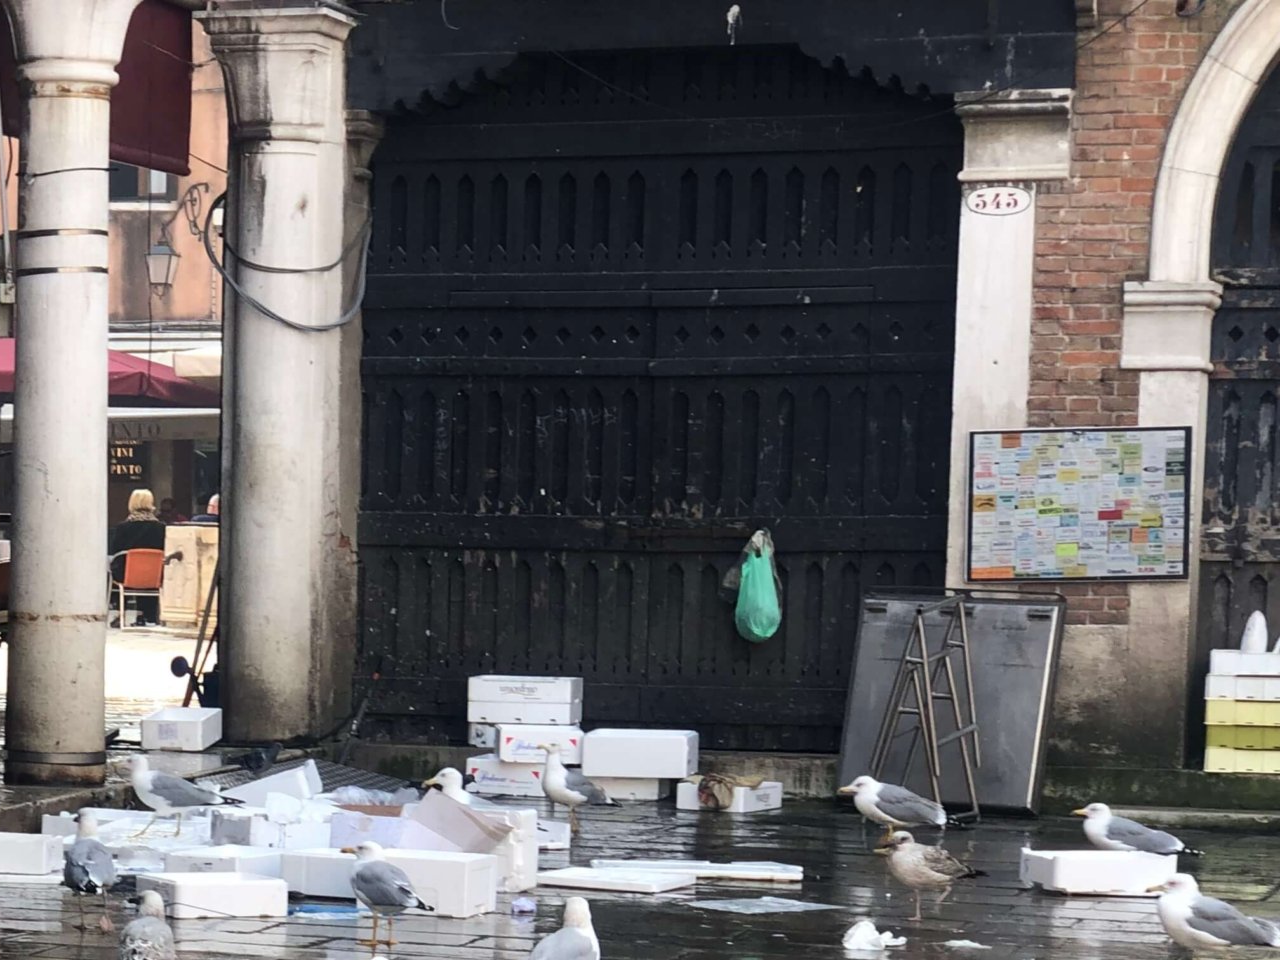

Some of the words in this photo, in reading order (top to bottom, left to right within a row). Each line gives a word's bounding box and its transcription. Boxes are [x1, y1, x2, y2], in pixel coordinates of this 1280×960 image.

[975, 192, 1018, 209] 545
[110, 422, 161, 439] INTO
[110, 464, 142, 474] PINTO
